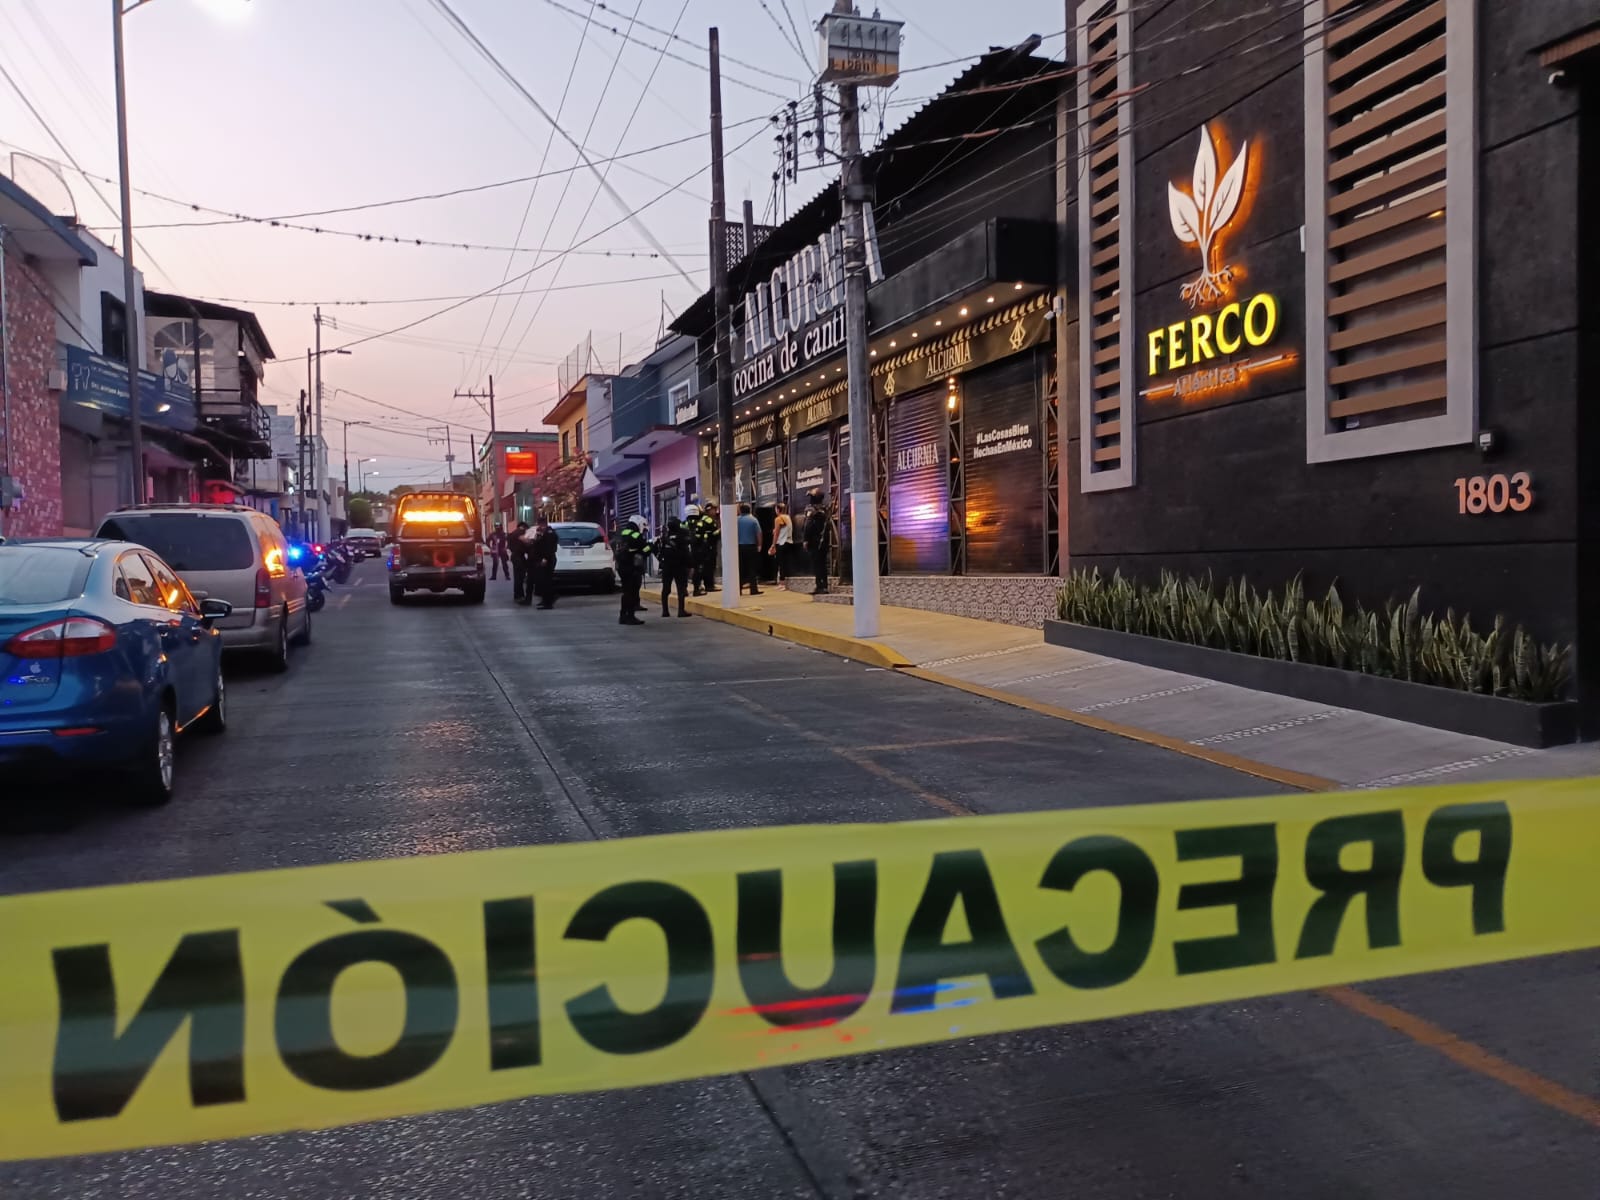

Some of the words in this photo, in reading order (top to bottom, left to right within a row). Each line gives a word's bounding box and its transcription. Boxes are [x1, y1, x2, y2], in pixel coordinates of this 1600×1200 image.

[744, 200, 884, 361] ALCURNA
[733, 354, 775, 397] cocina
[780, 331, 799, 374] de
[804, 307, 848, 361] canti
[926, 341, 972, 378] ALCURNIA
[1147, 292, 1277, 377] FERCO
[896, 442, 939, 472] ALCURNIA
[1454, 471, 1532, 514] 1803
